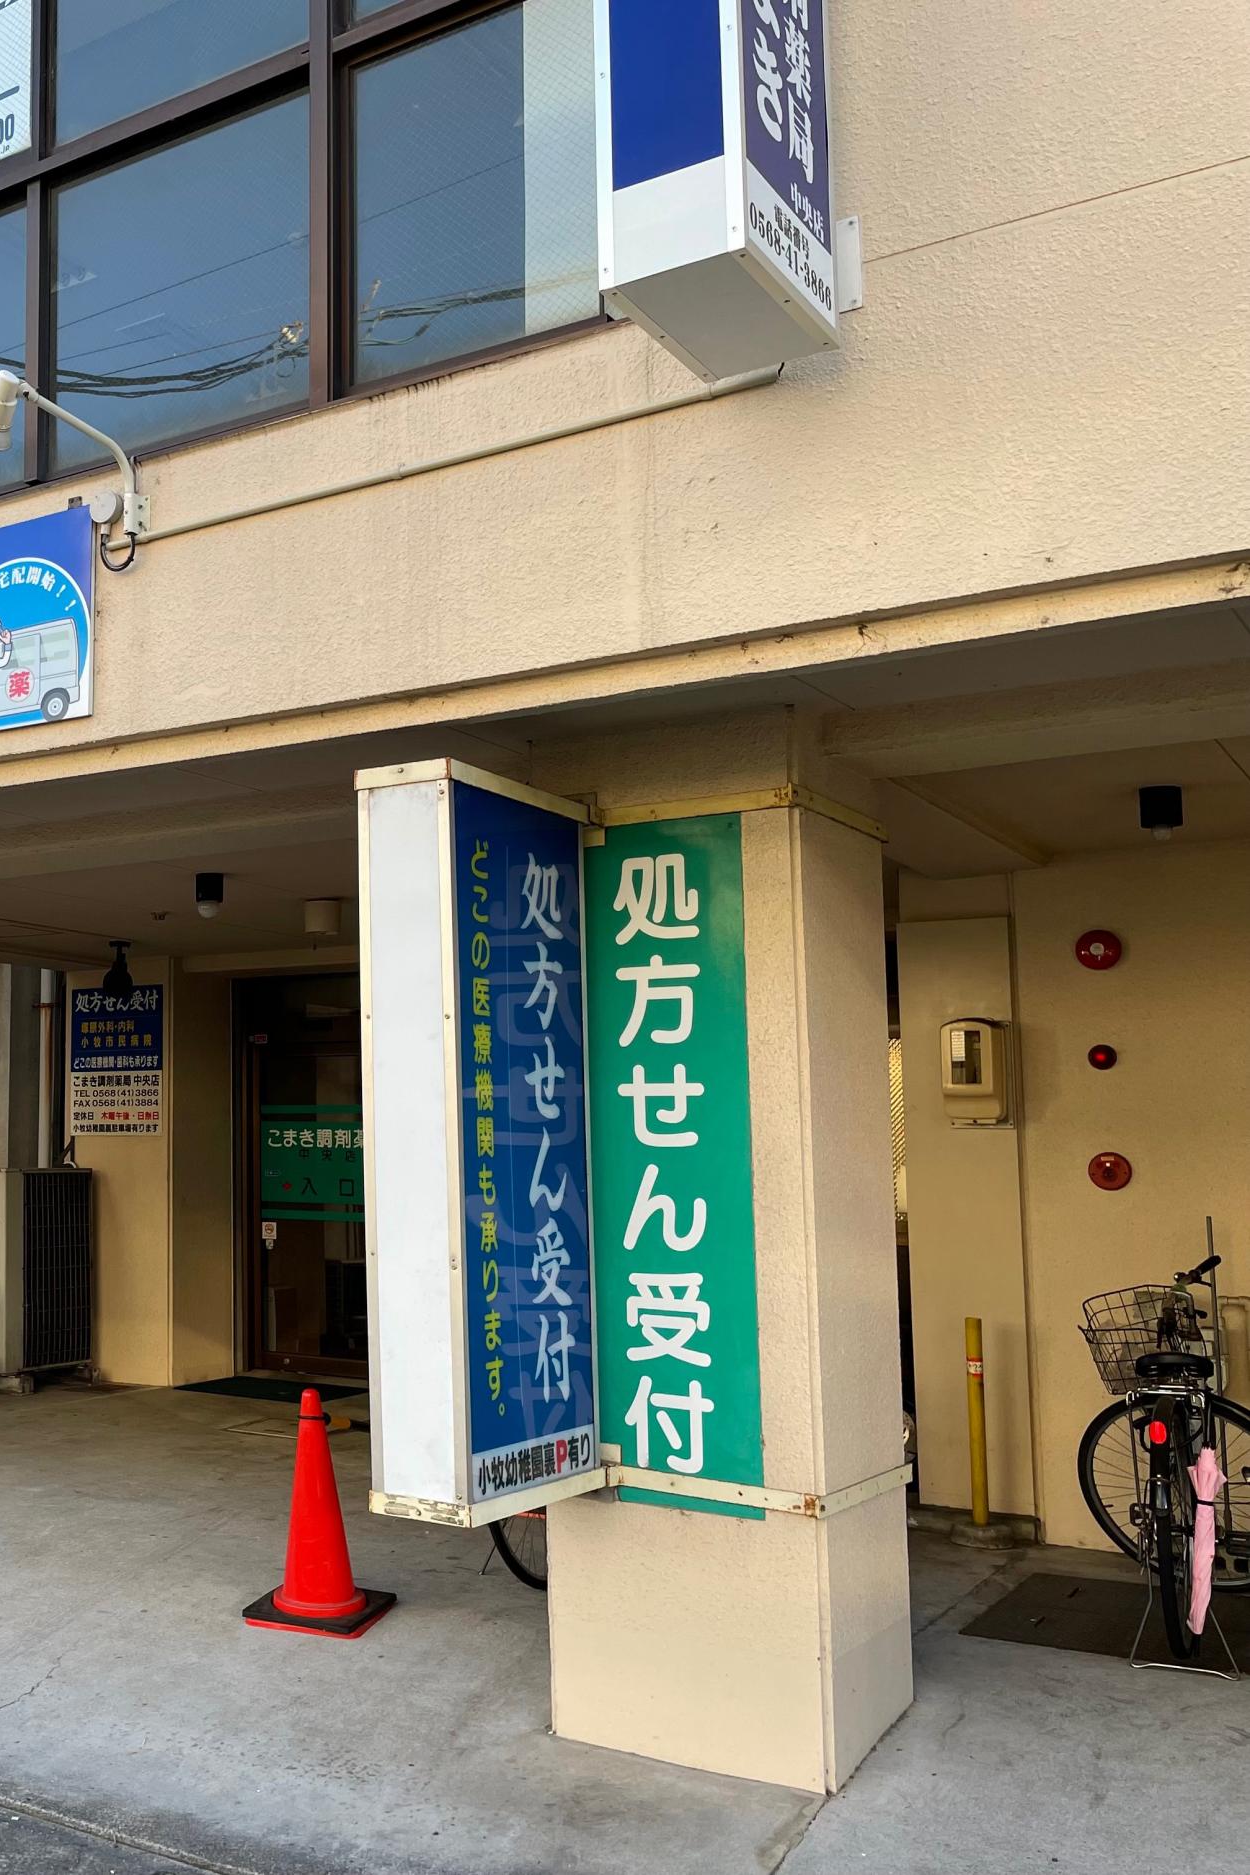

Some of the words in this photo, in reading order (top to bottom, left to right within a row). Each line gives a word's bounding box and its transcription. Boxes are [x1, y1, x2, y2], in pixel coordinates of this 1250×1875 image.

[774, 203, 811, 260] 電話番号
[790, 182, 825, 243] 中央店
[749, 201, 832, 312] 0568-41-3866
[9, 671, 31, 697] 薬
[75, 989, 159, 1013] 処方せん受付
[74, 1075, 131, 1087] こまき調剤薬局
[134, 1075, 159, 1087] 中央店
[93, 1089, 159, 1097] 0568(41)3866
[73, 1112, 94, 1120] 定休日
[92, 1099, 159, 1107] 0568(41)3884
[469, 839, 506, 1418] どこの医療機関も承ります。
[519, 851, 575, 1404] 処方せん受付
[613, 853, 714, 1475] 処方せん受付
[301, 1177, 355, 1197] 入口
[479, 1433, 590, 1495] 小牧幼稚園裏P有り
